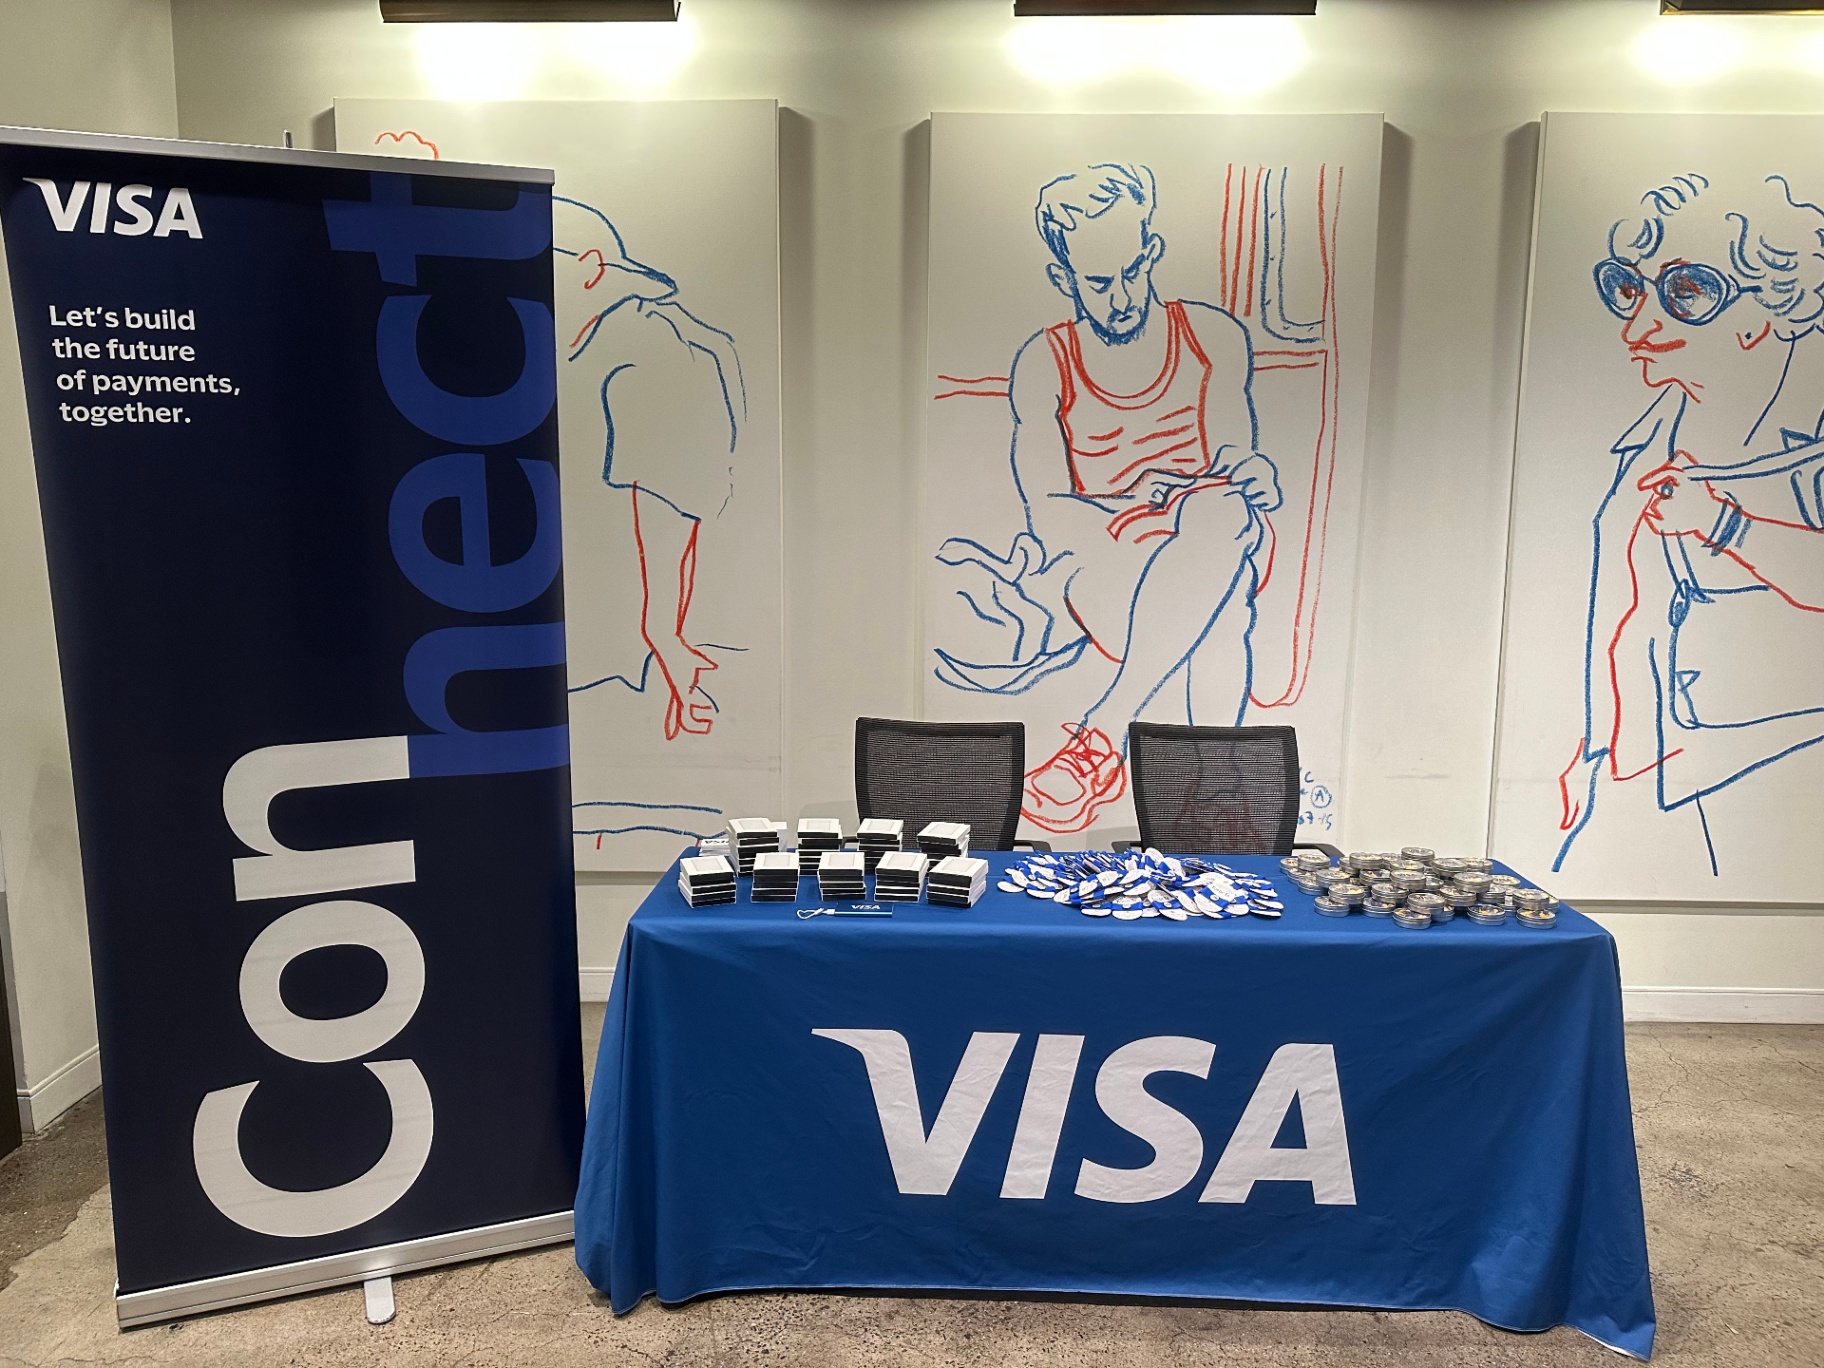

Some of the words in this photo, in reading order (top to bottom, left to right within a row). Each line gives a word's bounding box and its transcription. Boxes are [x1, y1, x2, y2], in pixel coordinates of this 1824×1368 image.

[22, 177, 203, 239] VISA
[49, 304, 119, 328] Let’s
[124, 307, 196, 331] build
[51, 337, 101, 359] the
[106, 338, 196, 362] future
[56, 369, 87, 391] of
[92, 373, 241, 396] payments,
[58, 401, 191, 427] together.
[811, 1028, 1357, 1206] VISA
